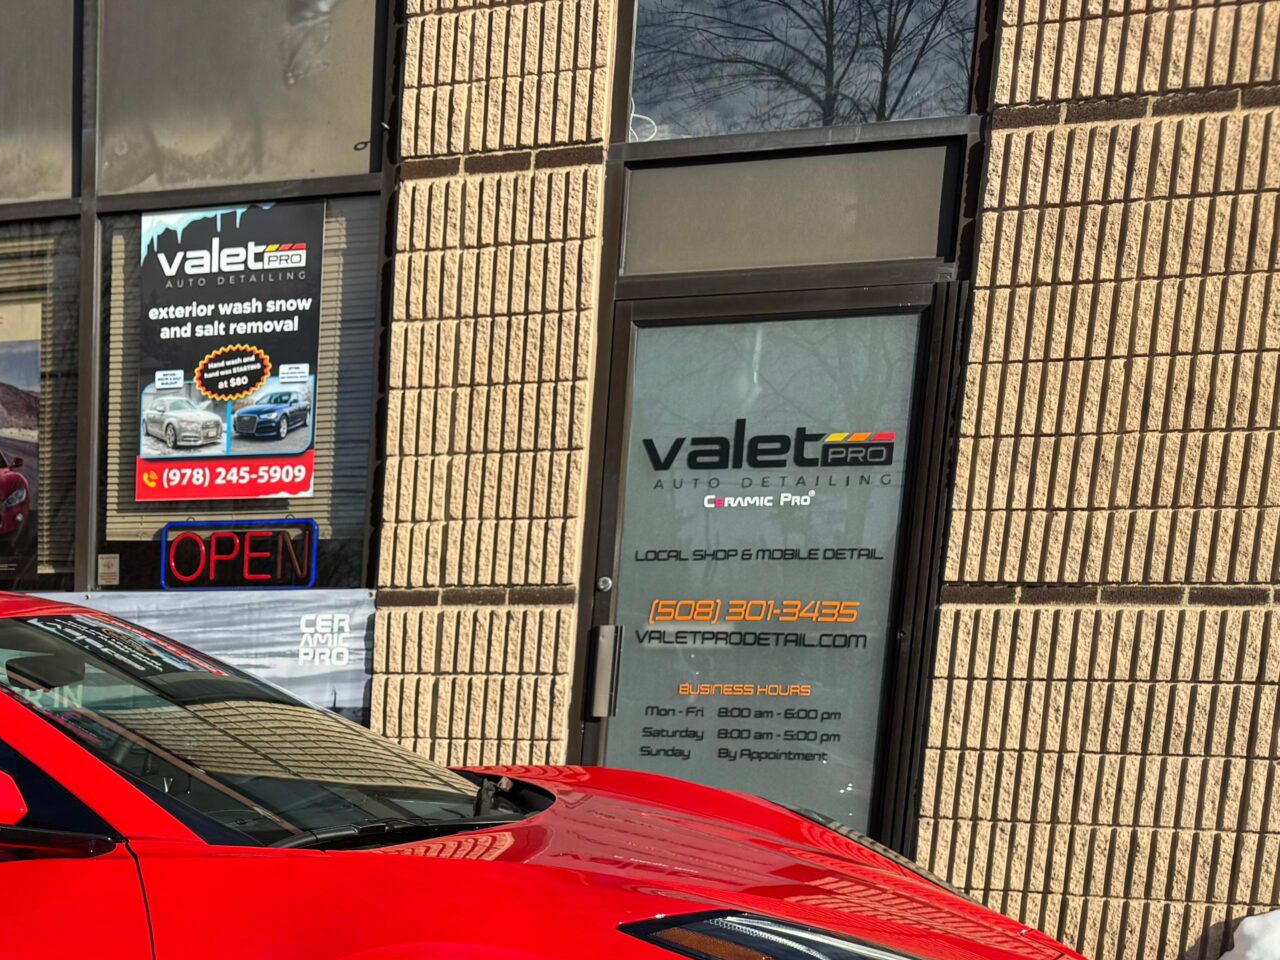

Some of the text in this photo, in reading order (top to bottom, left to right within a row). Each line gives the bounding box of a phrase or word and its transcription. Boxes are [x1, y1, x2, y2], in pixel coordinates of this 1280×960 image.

[157, 237, 303, 277] valet PRO
[165, 271, 306, 289] AUTO DETAILING
[148, 297, 312, 320] exterior wash snow
[160, 315, 299, 339] and salt removal
[243, 354, 255, 363] and
[204, 370, 219, 379] hand
[218, 375, 248, 389] at $80
[642, 419, 888, 471] valet PRO
[162, 465, 306, 488] (978) 245-5909
[653, 474, 892, 490] AUTO DETAILING
[169, 530, 310, 582] OPEN
[635, 548, 884, 562] LOCAL SHOP & MOBILE DETAIL
[648, 599, 860, 625] (508) 301-3435
[300, 613, 351, 633] CER
[300, 633, 351, 648] AMIC
[635, 630, 867, 648] VALETPRODETAIL.COM
[299, 647, 349, 666] PRO
[678, 683, 812, 696] BUSINESS HOURS
[645, 706, 676, 717] Mon
[685, 706, 705, 718] Fri
[717, 707, 751, 718] 8:00
[754, 710, 773, 718] am
[784, 708, 818, 720] 6:00
[820, 711, 842, 722] pm
[641, 727, 704, 741] Saturday
[717, 729, 751, 740] 8:00
[754, 732, 773, 740] am
[783, 730, 818, 741] 5:00
[820, 733, 841, 744] pm
[640, 746, 828, 762] Sunday By Appointment
